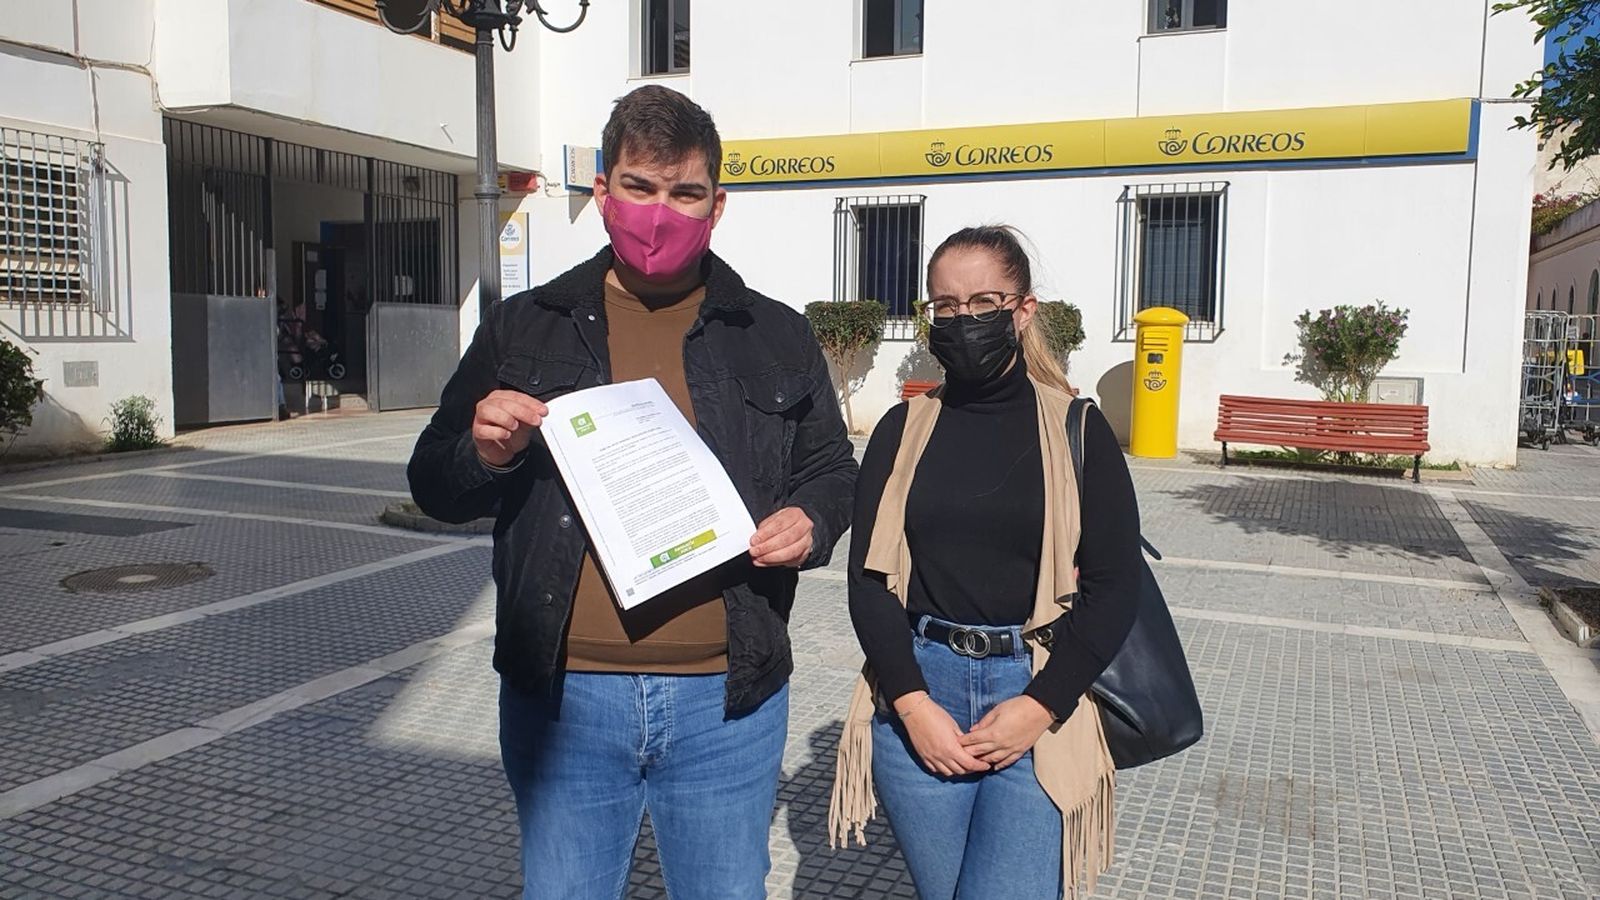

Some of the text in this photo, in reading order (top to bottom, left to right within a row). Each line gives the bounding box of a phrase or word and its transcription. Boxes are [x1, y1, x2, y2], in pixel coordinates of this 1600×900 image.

[1192, 131, 1305, 155] CORREOS
[750, 156, 835, 176] CORREOS
[956, 144, 1053, 166] CORREOS
